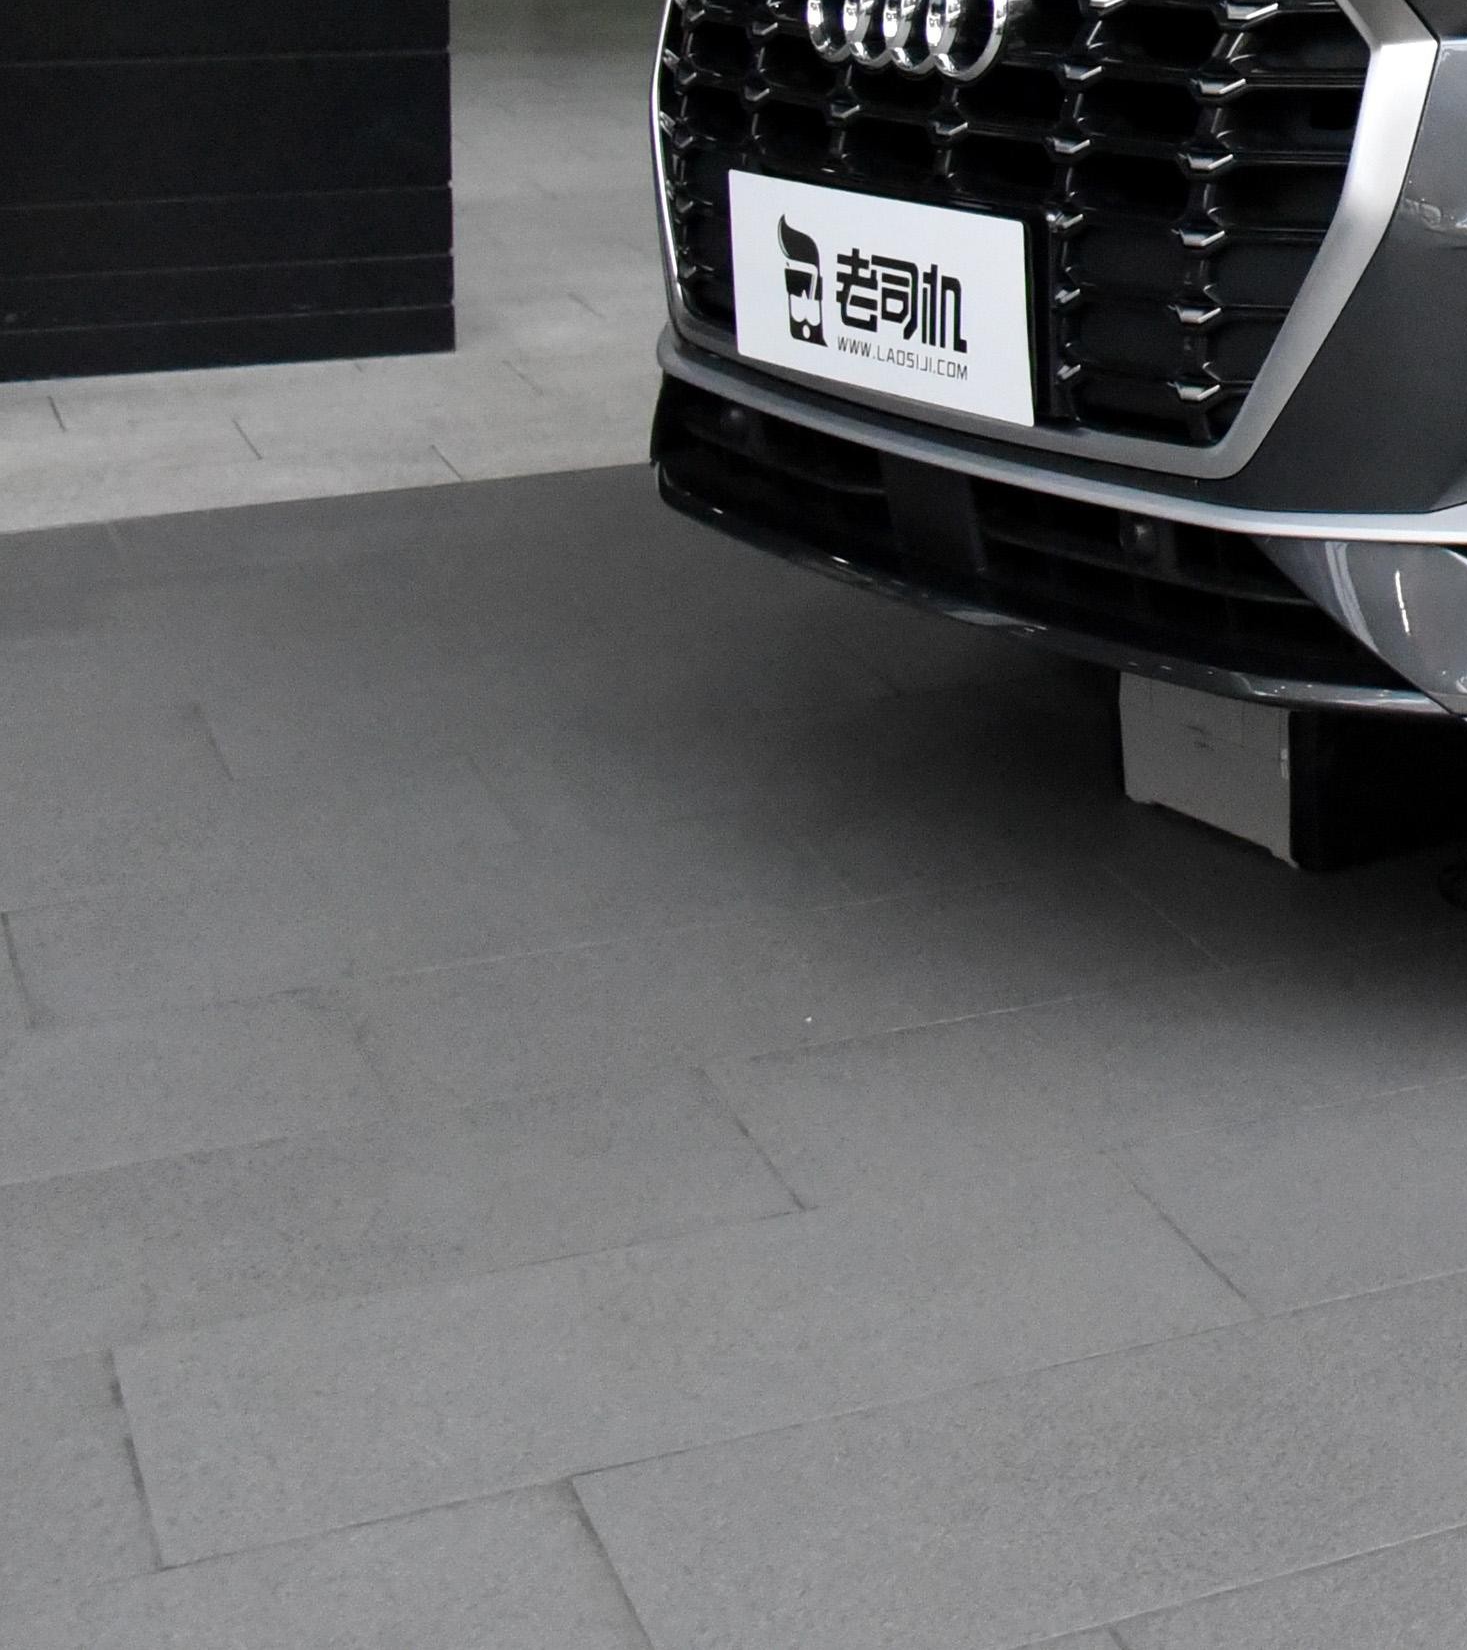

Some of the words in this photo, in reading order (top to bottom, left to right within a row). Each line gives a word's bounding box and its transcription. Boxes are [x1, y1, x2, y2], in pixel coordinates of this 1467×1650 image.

[835, 247, 968, 354] 老司机
[837, 333, 968, 381] WWW.LAOSIJI.COM
